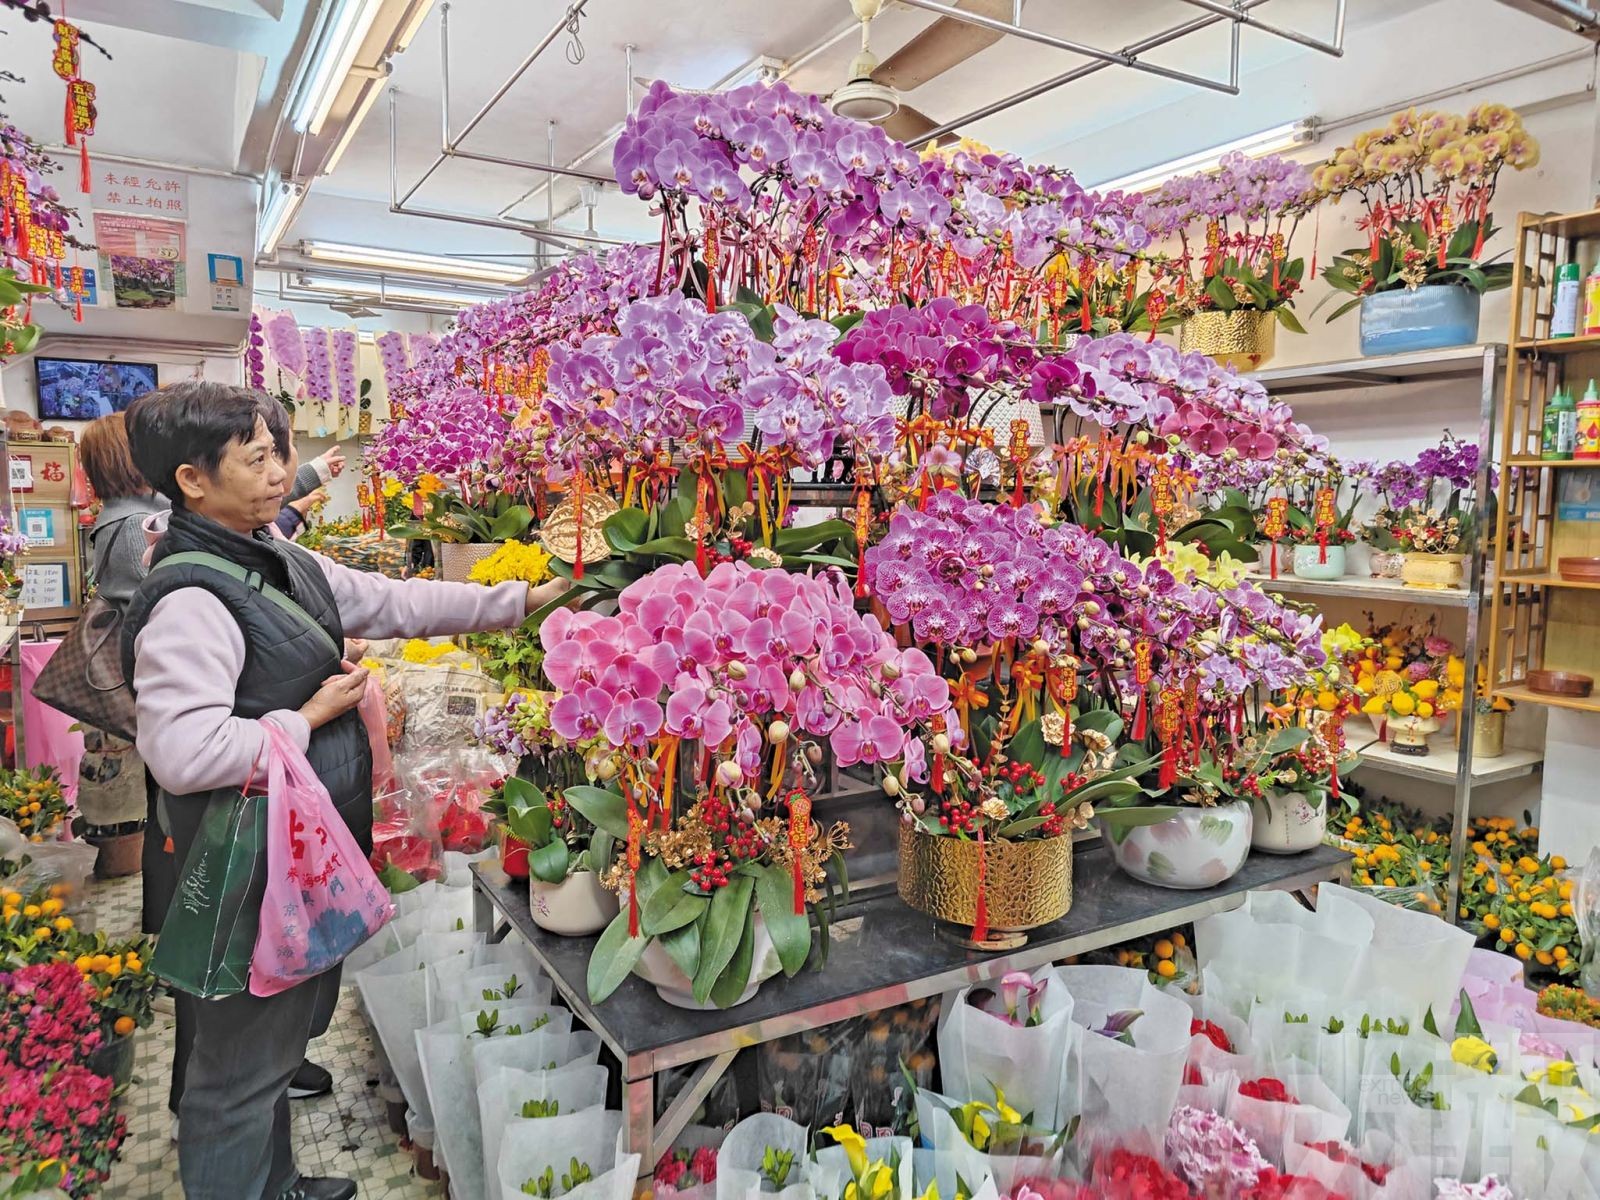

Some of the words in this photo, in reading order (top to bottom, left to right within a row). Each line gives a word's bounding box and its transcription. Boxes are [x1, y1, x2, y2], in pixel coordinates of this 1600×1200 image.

[104, 171, 181, 194] 未經允許
[107, 191, 183, 211] 禁止拍照
[41, 461, 65, 481] 福
